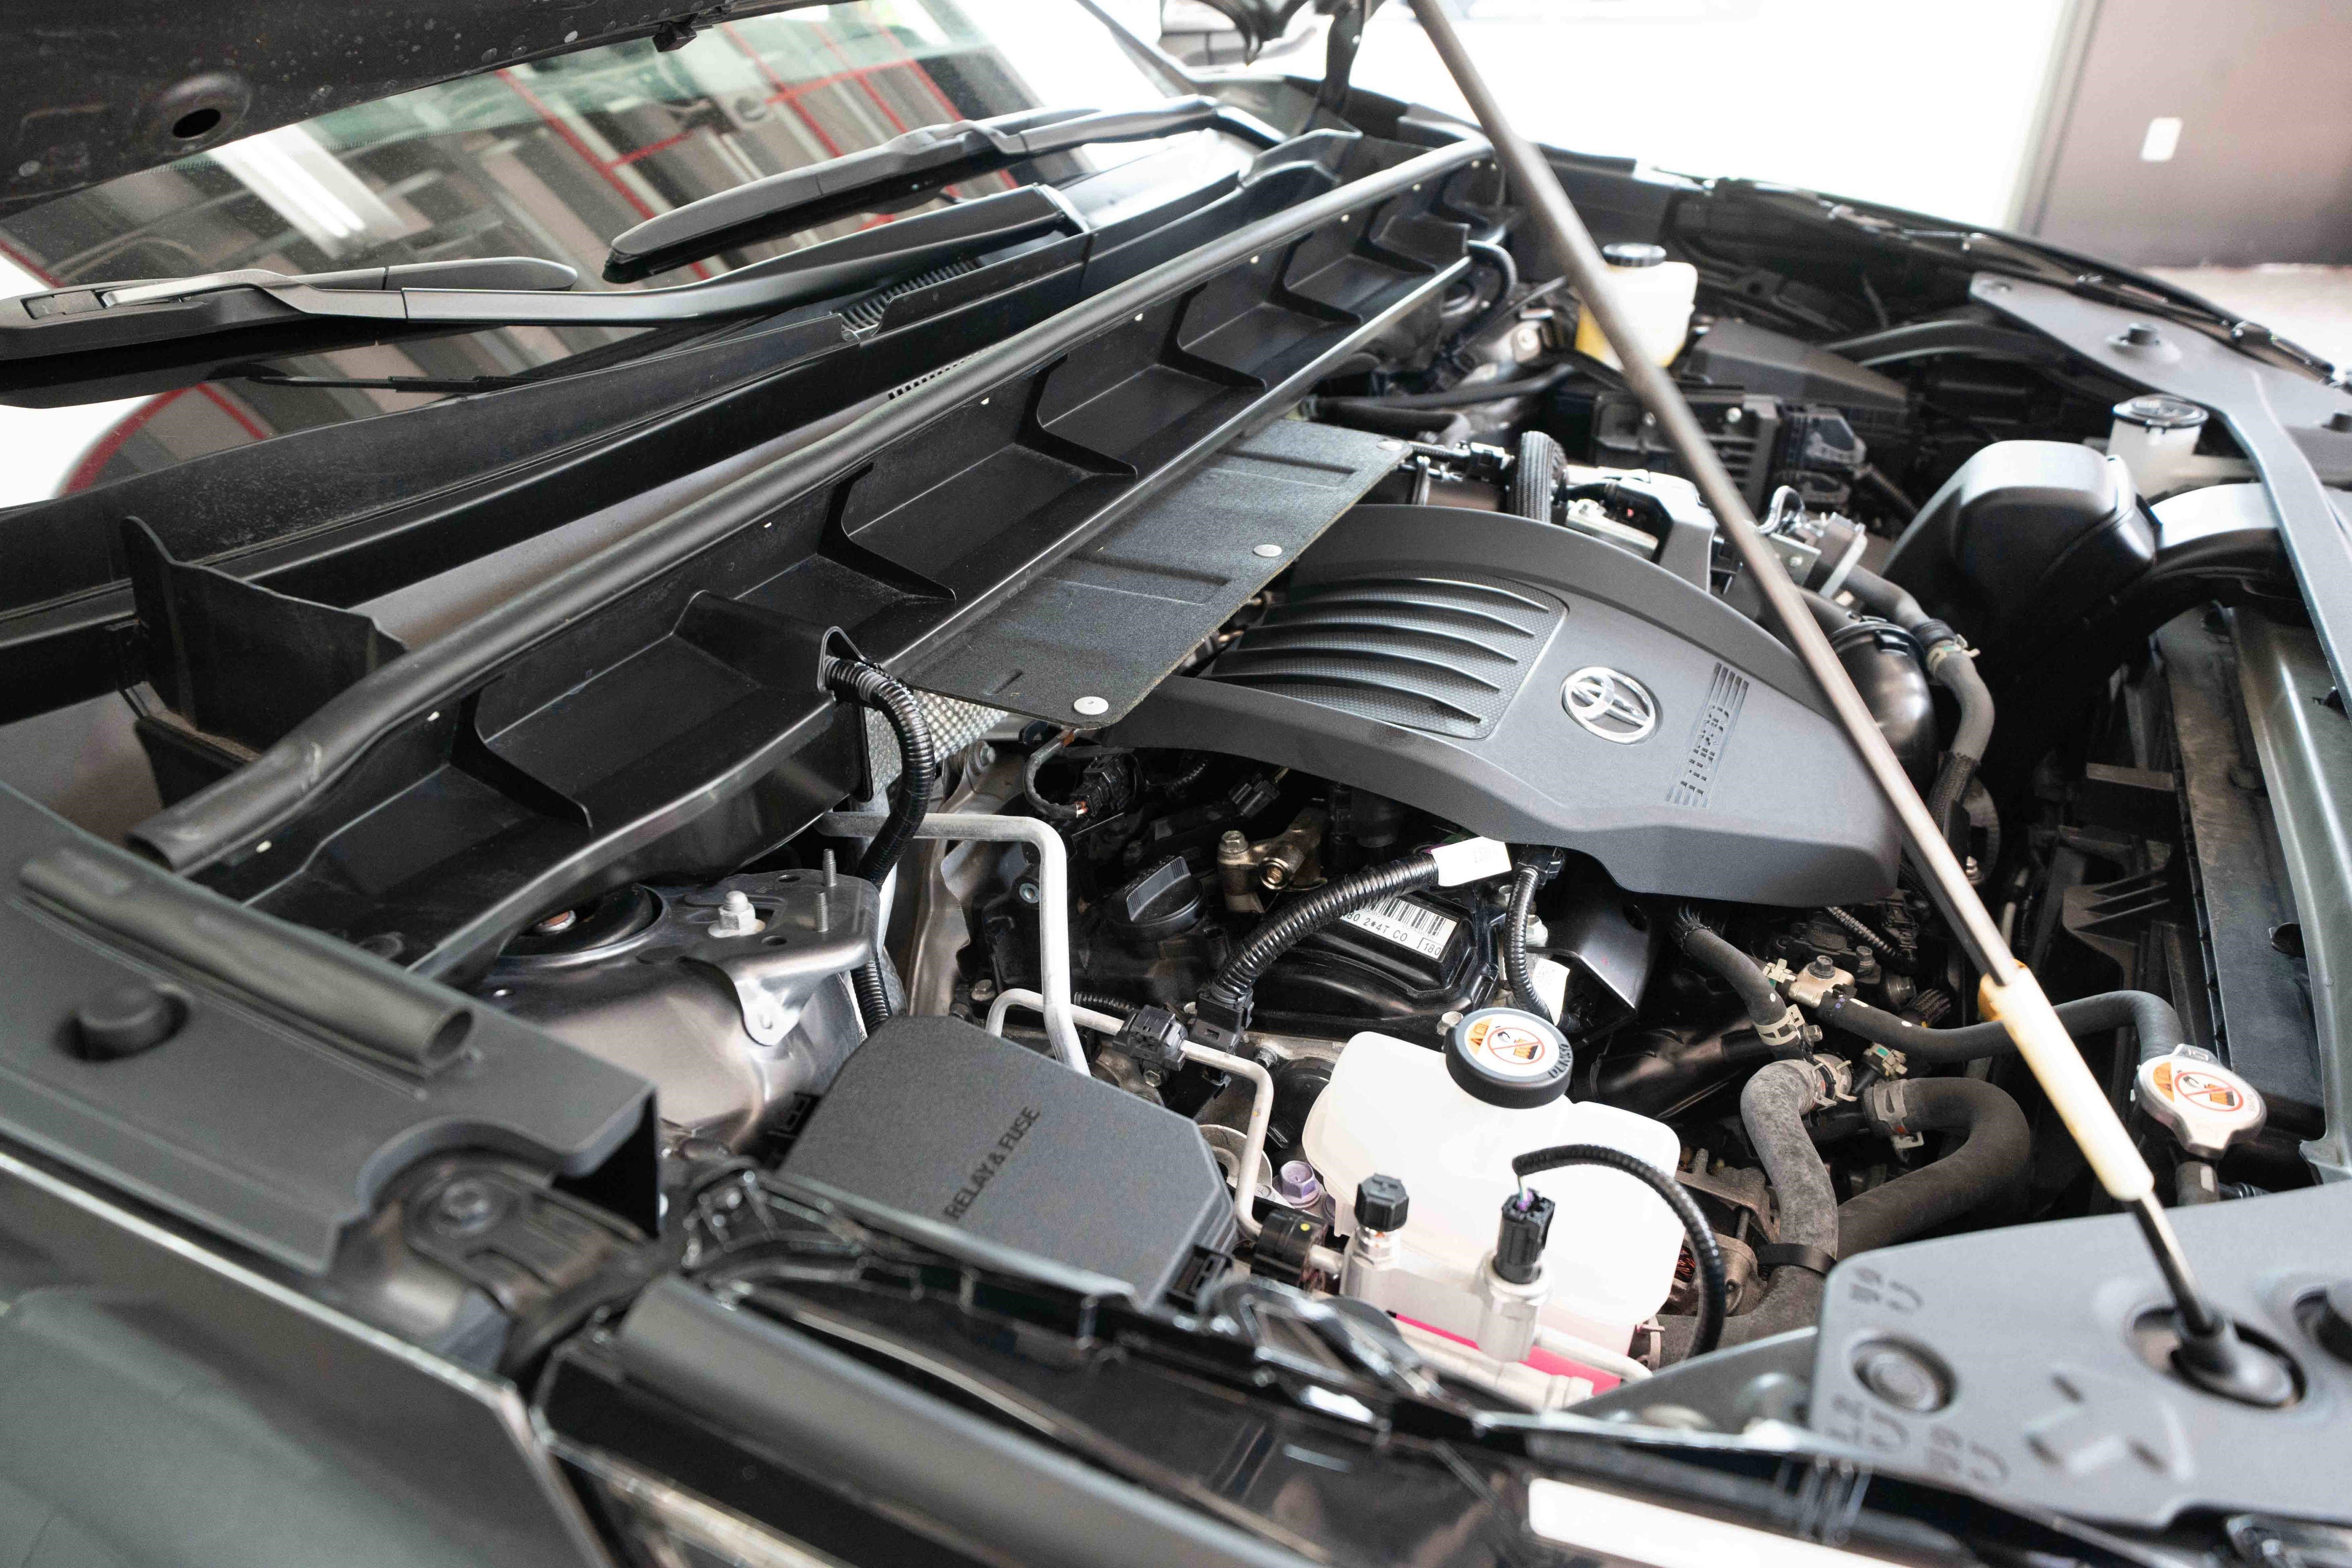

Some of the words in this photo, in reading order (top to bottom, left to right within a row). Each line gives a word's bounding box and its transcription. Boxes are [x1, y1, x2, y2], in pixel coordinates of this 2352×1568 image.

[1680, 705, 1729, 795] TURBO
[1343, 911, 1361, 922] 80
[1424, 943, 1441, 956] 180
[1548, 1043, 1572, 1078] DENSO
[944, 1163, 995, 1221] RELAY
[988, 1152, 1006, 1166] &
[998, 1106, 1040, 1151] FUSE
